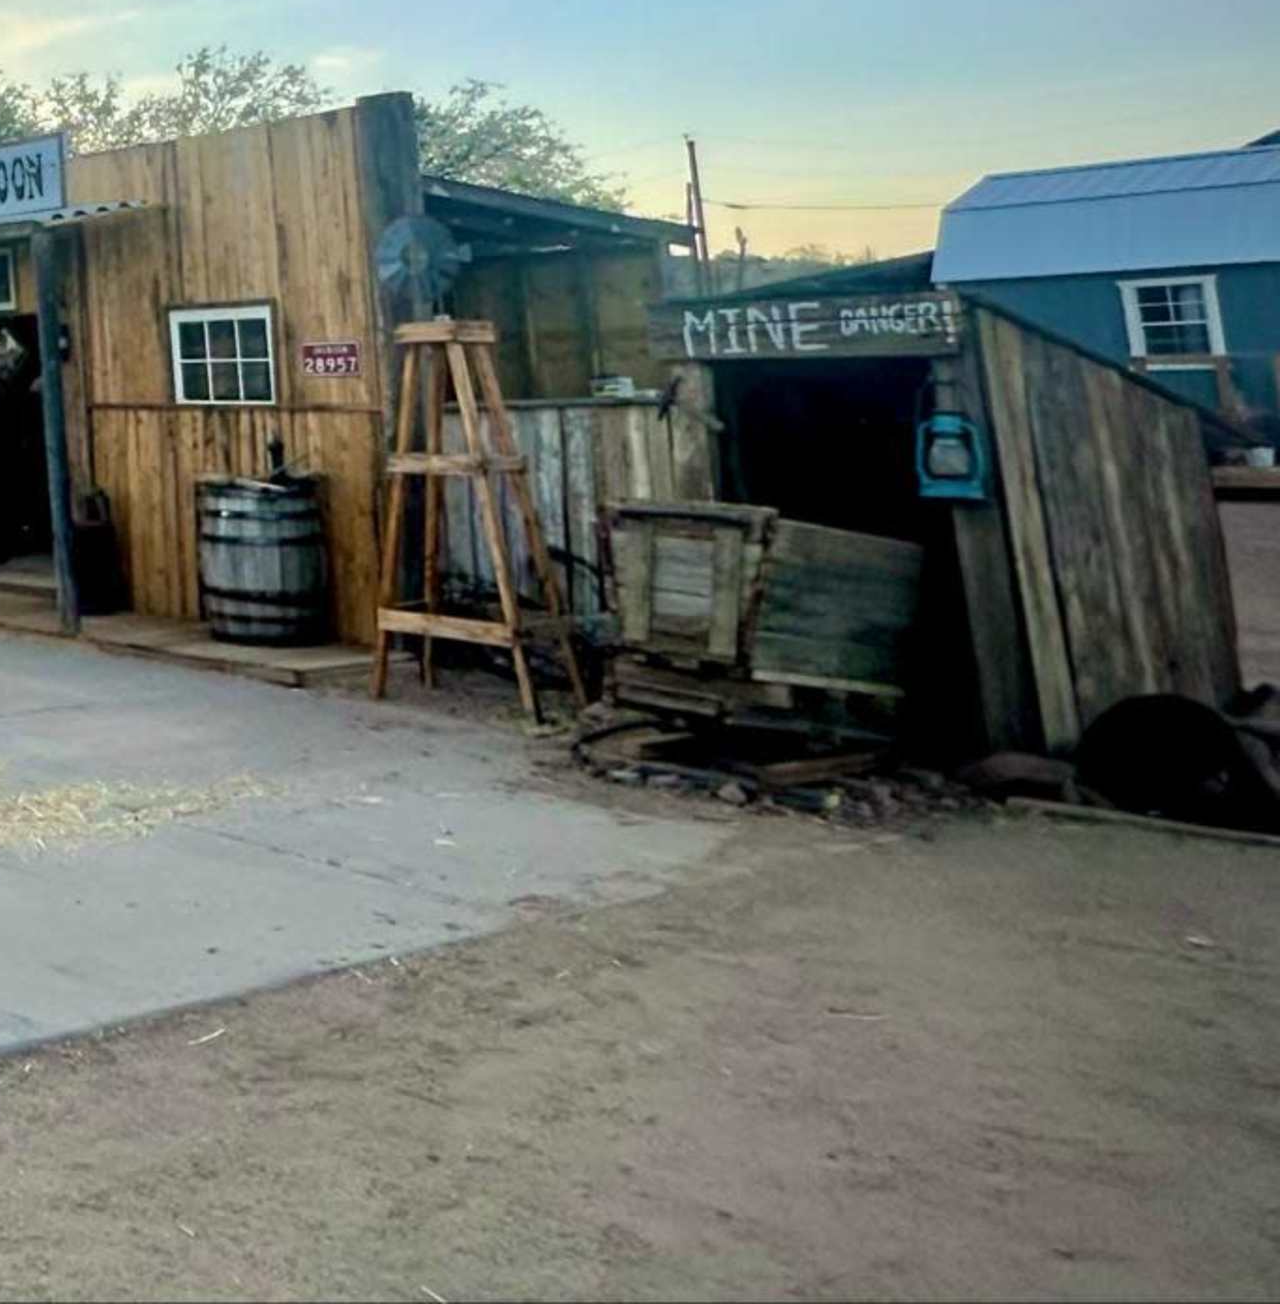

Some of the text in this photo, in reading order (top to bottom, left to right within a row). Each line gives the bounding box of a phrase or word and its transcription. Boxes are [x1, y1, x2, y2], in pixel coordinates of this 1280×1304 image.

[682, 299, 957, 357] MINE DANGER!
[304, 357, 357, 373] 28957
